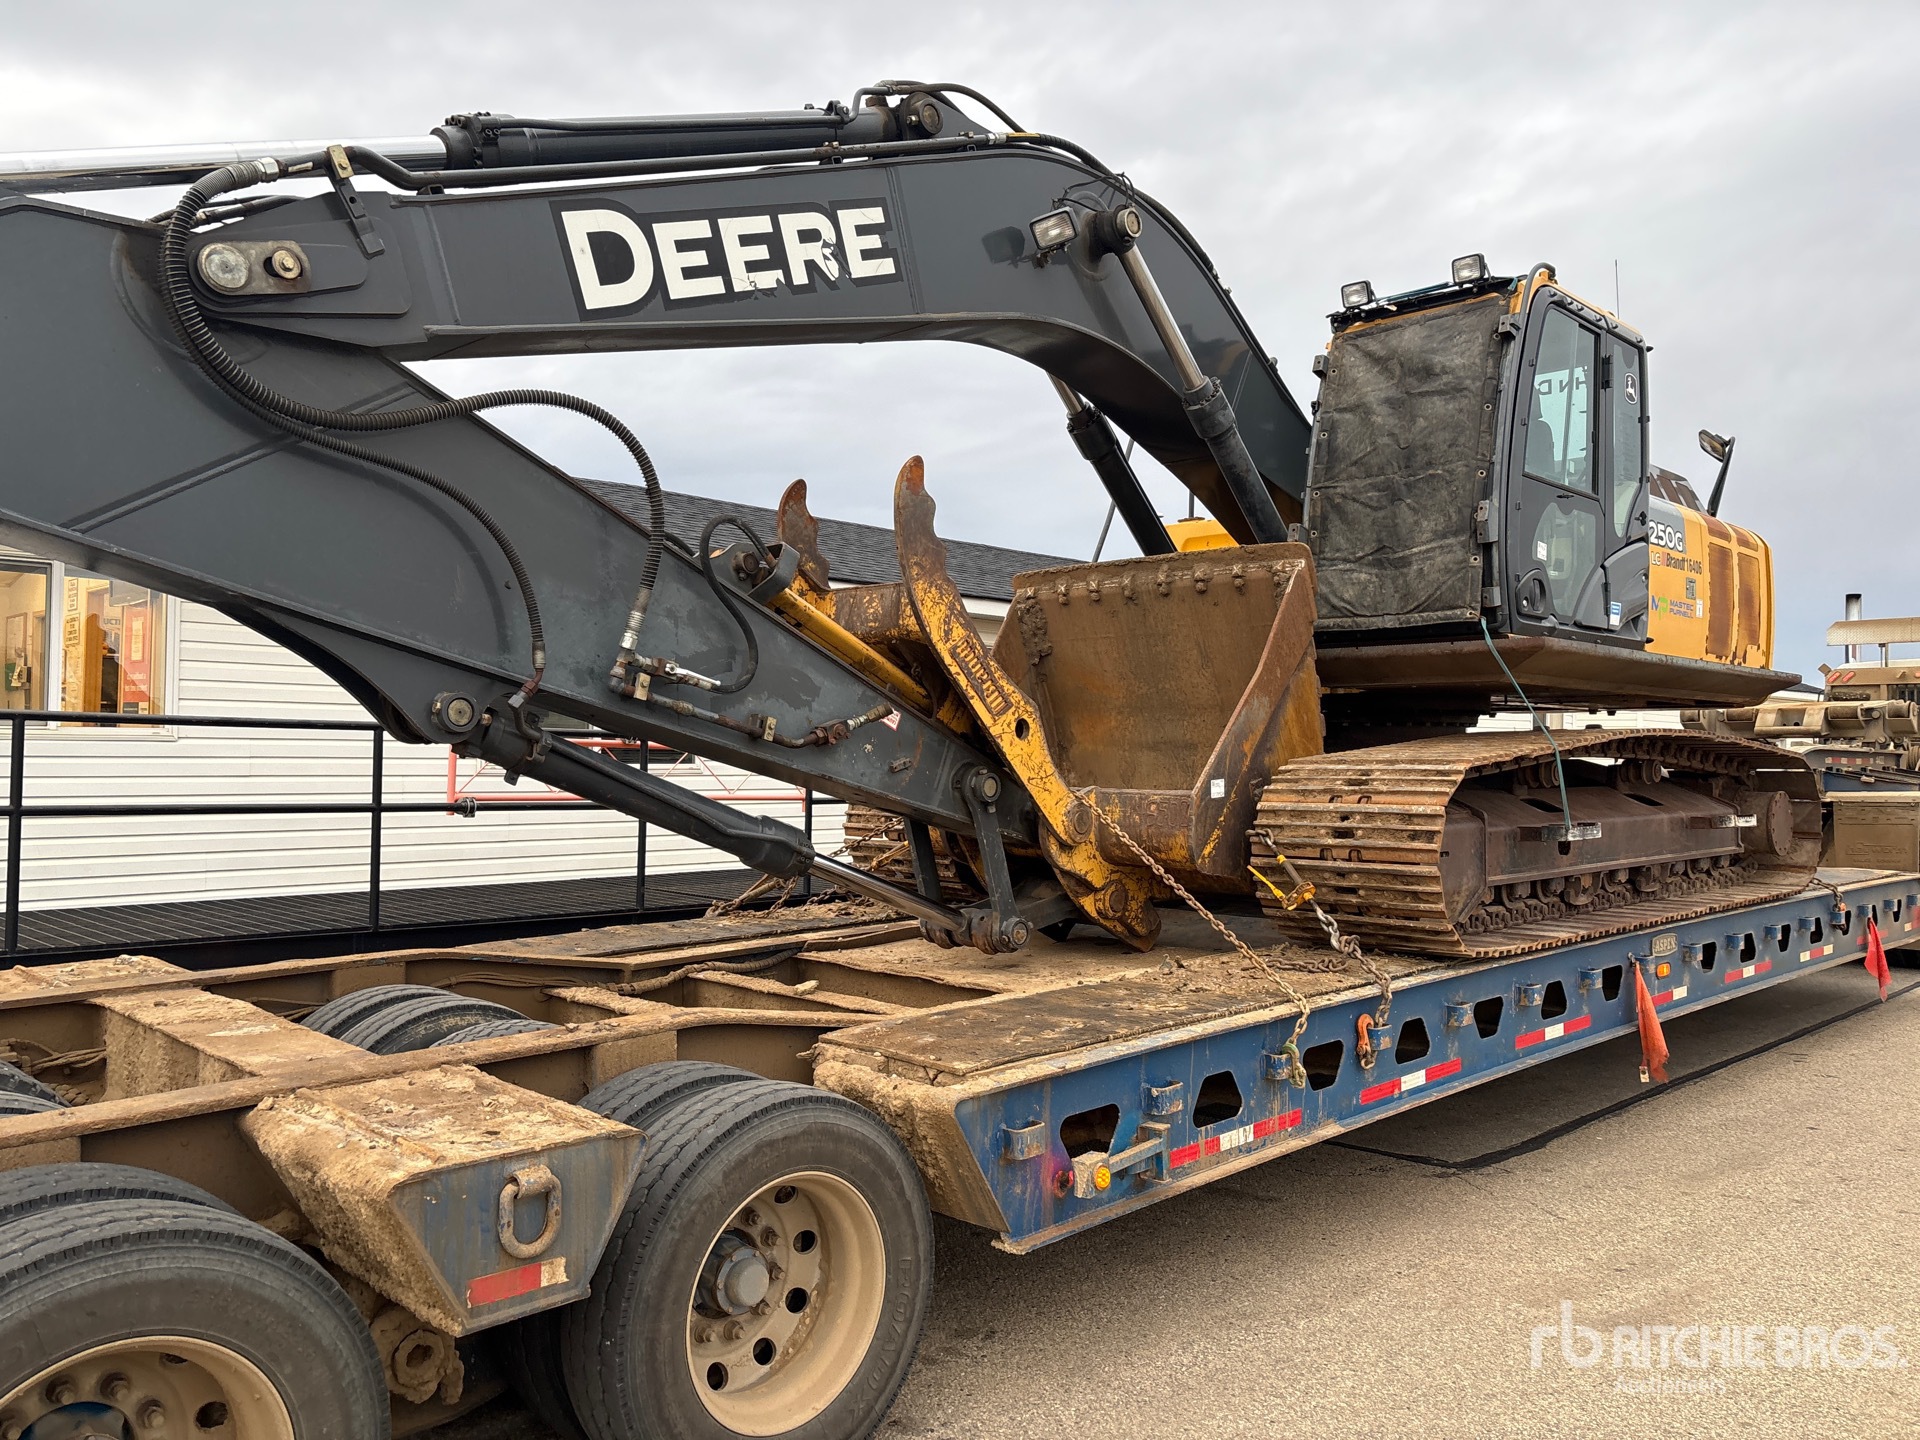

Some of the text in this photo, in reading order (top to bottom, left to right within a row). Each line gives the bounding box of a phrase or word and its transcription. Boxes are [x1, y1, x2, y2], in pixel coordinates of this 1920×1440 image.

[560, 207, 896, 310] DEERE
[1648, 520, 1683, 552] 250G
[1650, 550, 1661, 566] LC
[1666, 552, 1686, 571] Brandt
[1669, 599, 1694, 612] MASTEC
[1655, 937, 1677, 952] ASPEN
